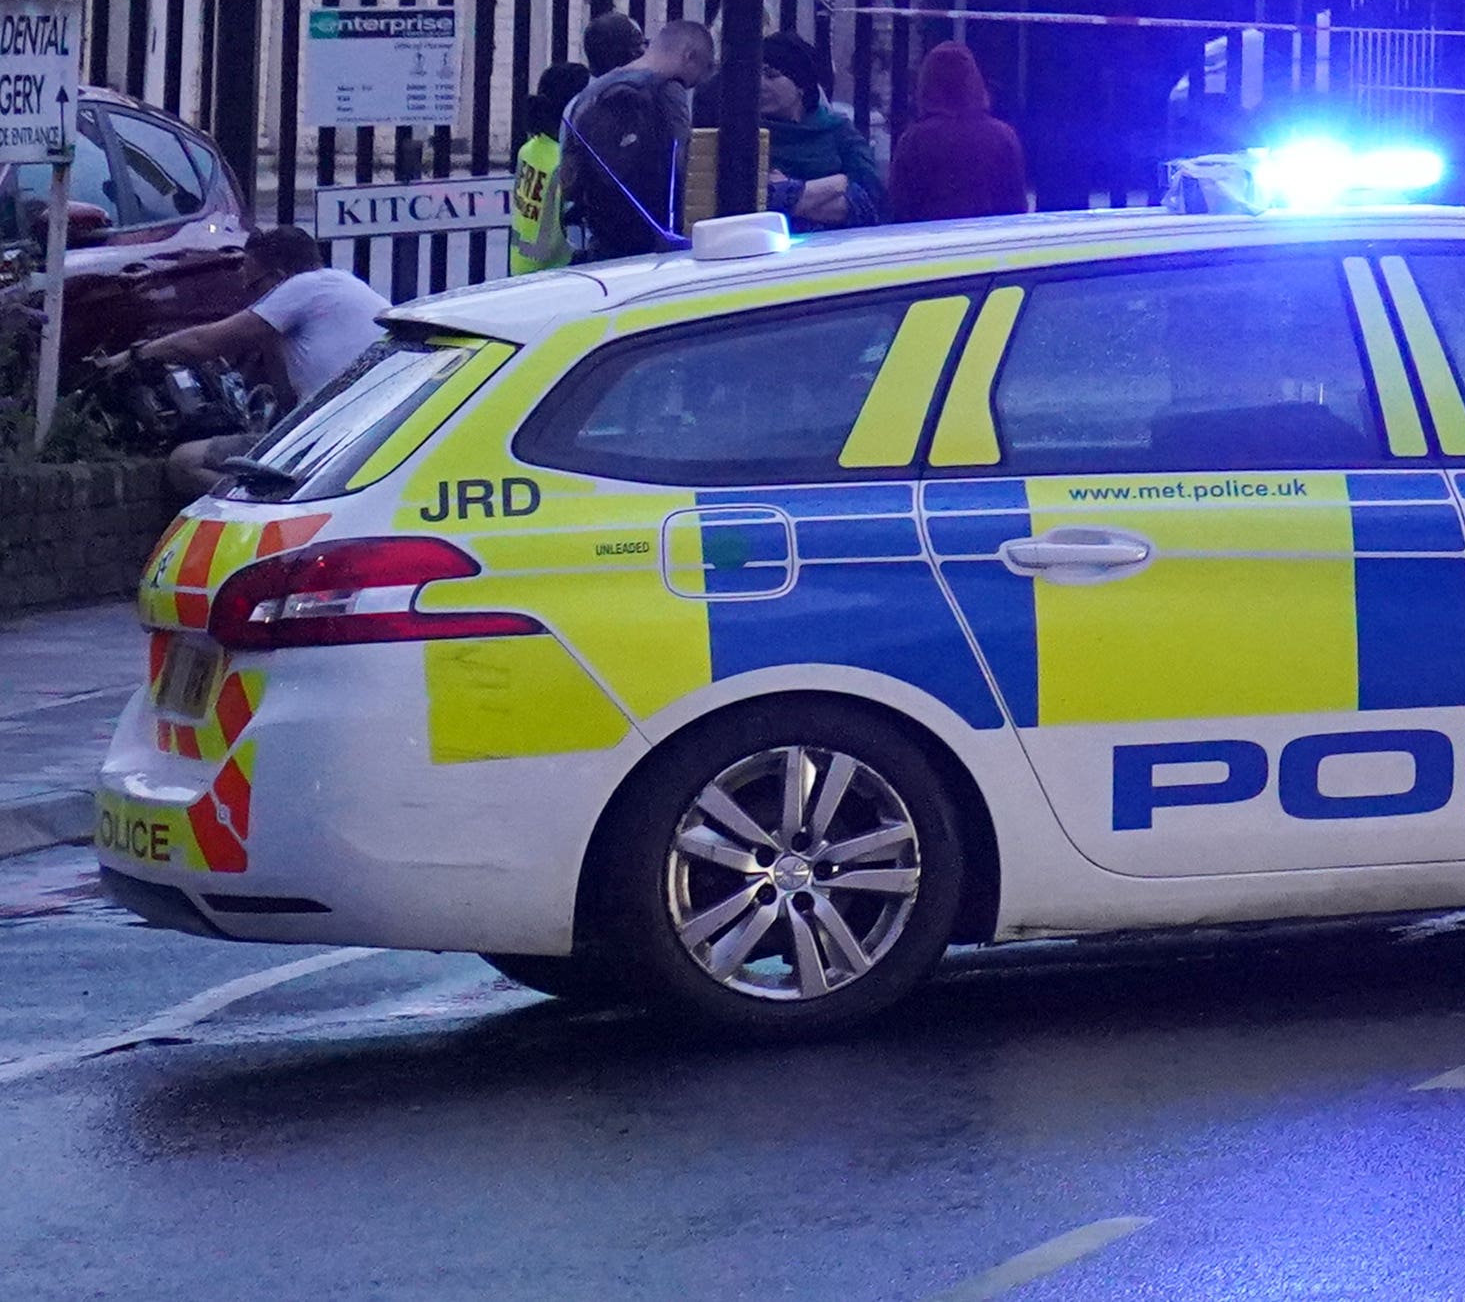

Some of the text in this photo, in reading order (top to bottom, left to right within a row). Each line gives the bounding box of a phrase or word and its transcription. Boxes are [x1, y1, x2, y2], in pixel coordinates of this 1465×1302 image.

[0, 14, 70, 57] DENTAL
[337, 190, 484, 226] KITCAT
[419, 478, 542, 522] JRD
[1068, 476, 1308, 503] www.met.police.uk
